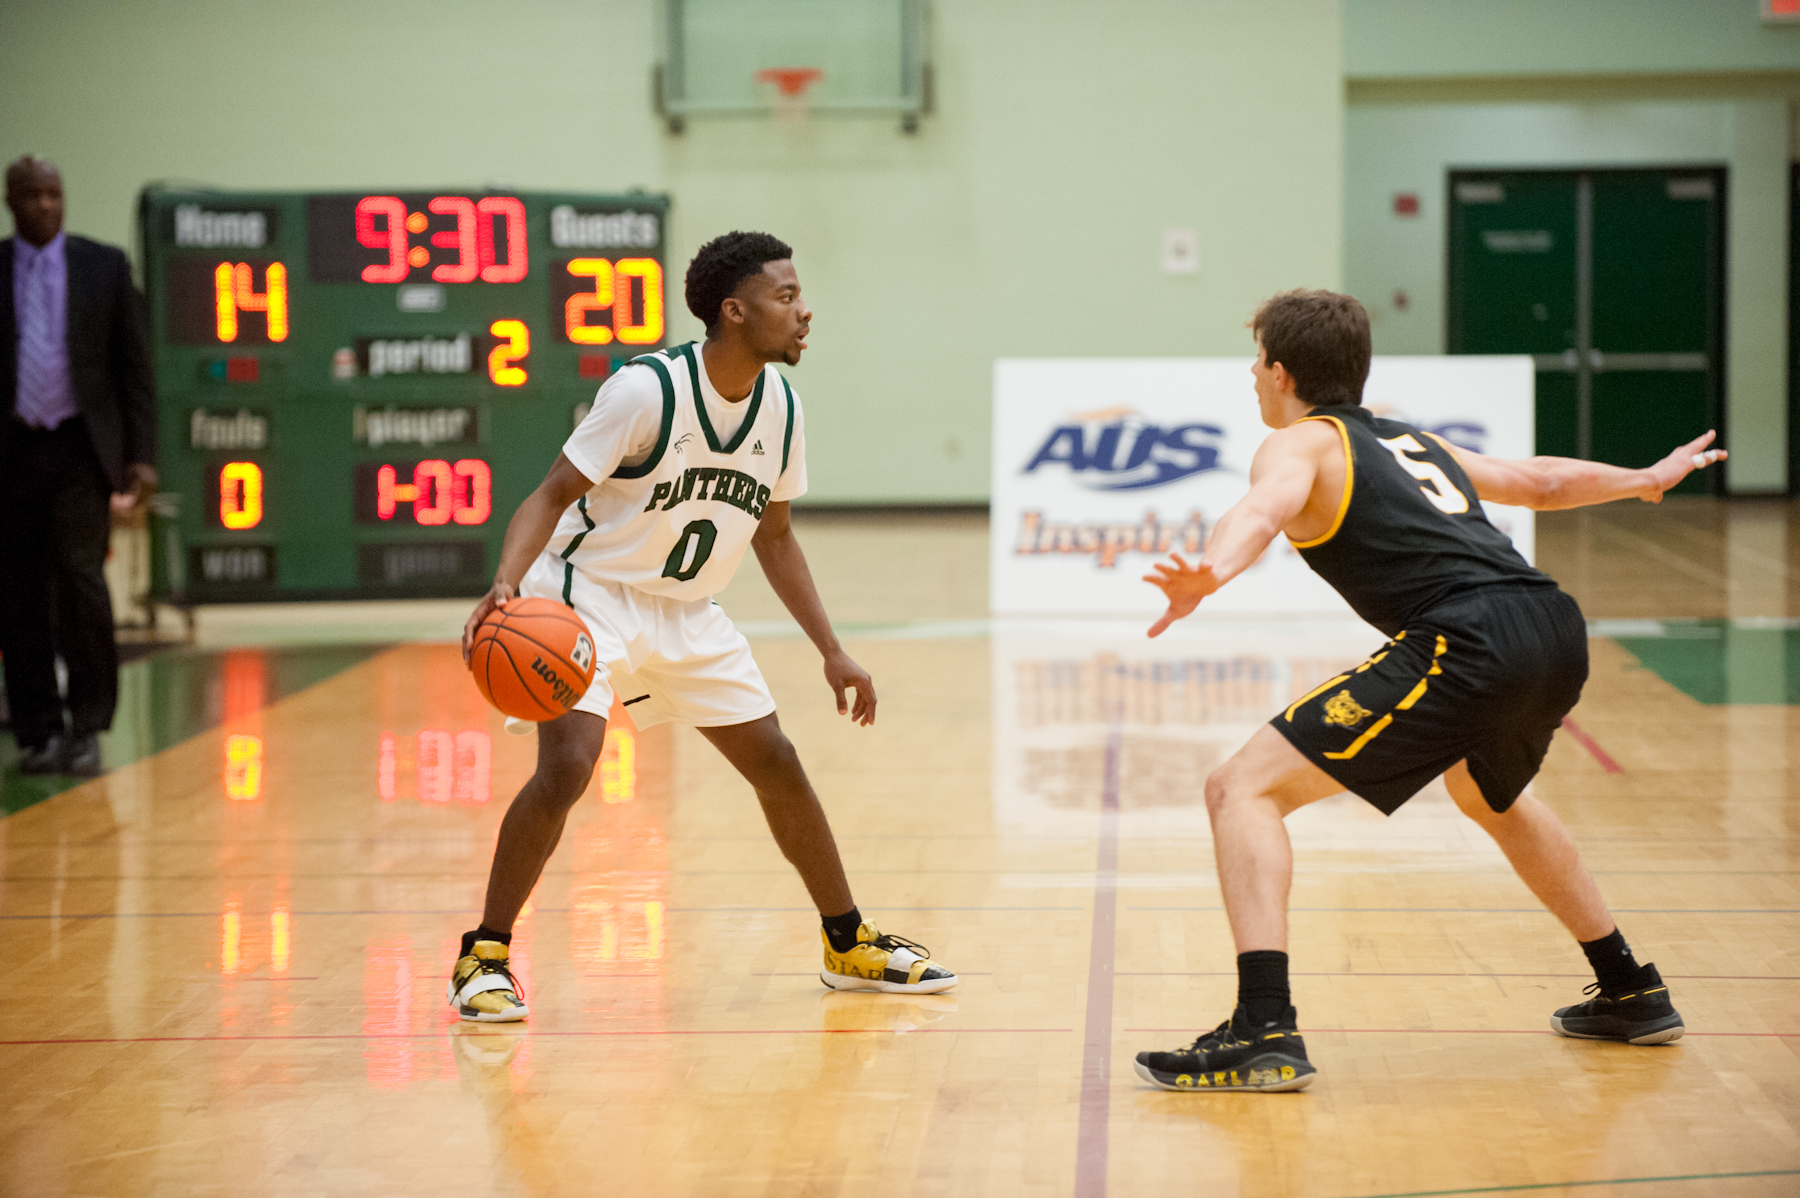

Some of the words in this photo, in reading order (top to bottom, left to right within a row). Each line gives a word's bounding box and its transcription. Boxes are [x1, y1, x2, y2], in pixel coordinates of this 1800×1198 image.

[174, 204, 267, 248] Home
[355, 196, 529, 283] 9:30
[551, 205, 659, 247] Guests
[214, 261, 289, 342] 14
[565, 257, 665, 345] 20
[368, 332, 472, 378] period
[488, 319, 531, 386] 2
[220, 461, 263, 530] 0
[643, 467, 771, 521] PANTHERS
[1376, 433, 1469, 515] 5
[661, 519, 718, 582] 0
